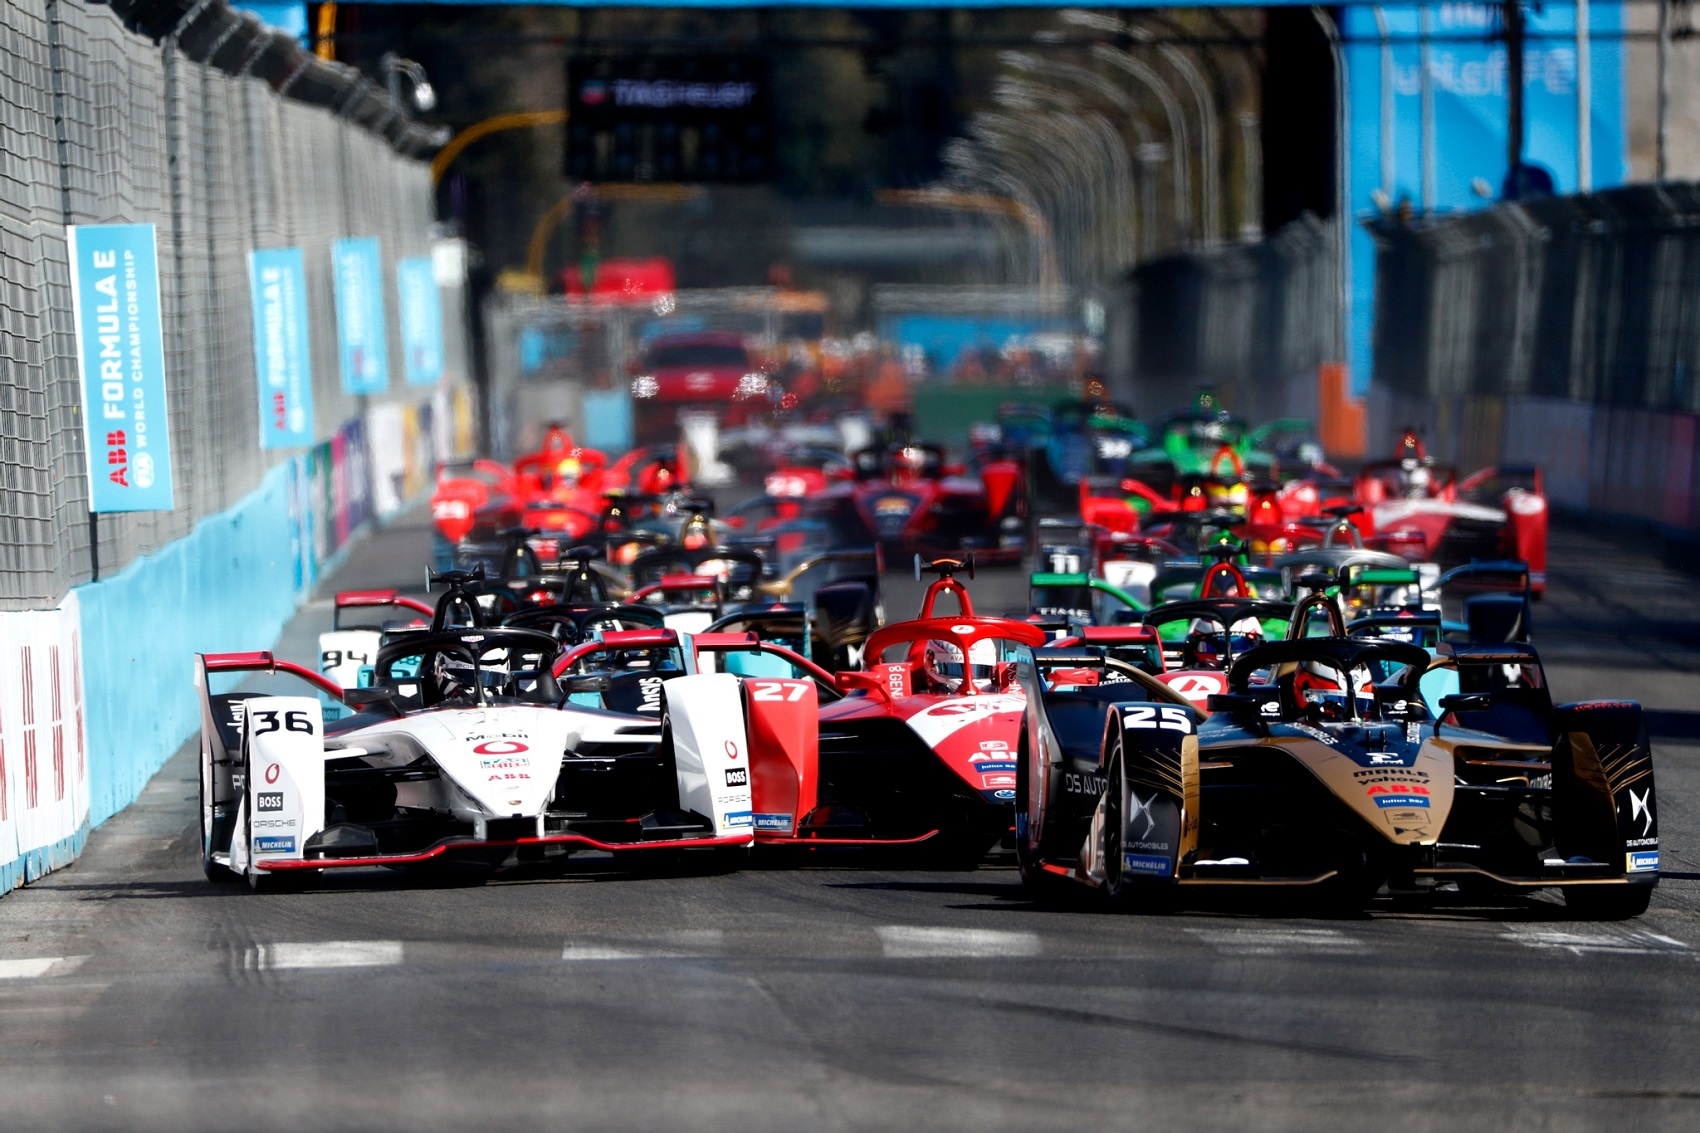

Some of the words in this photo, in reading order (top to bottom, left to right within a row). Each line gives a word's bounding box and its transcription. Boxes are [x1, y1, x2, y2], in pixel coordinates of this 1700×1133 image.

[93, 249, 116, 269] E
[124, 249, 143, 382] CHAMPIONSHIP
[95, 273, 126, 419] FORMULA
[133, 387, 147, 448] WORLD
[107, 428, 129, 487] ABB
[322, 650, 368, 672] 94
[753, 682, 809, 702] 27
[253, 710, 313, 736] 36
[1123, 706, 1191, 734] 25
[488, 773, 531, 781] ABB
[726, 770, 746, 784] BOSS
[1366, 784, 1431, 796] ABB
[259, 796, 281, 808] BOSS
[253, 819, 296, 827] ORSCHE
[261, 840, 292, 848] MICHELIN
[1128, 841, 1169, 850] AUTOMOBILES
[1132, 860, 1166, 870] MICHELIN
